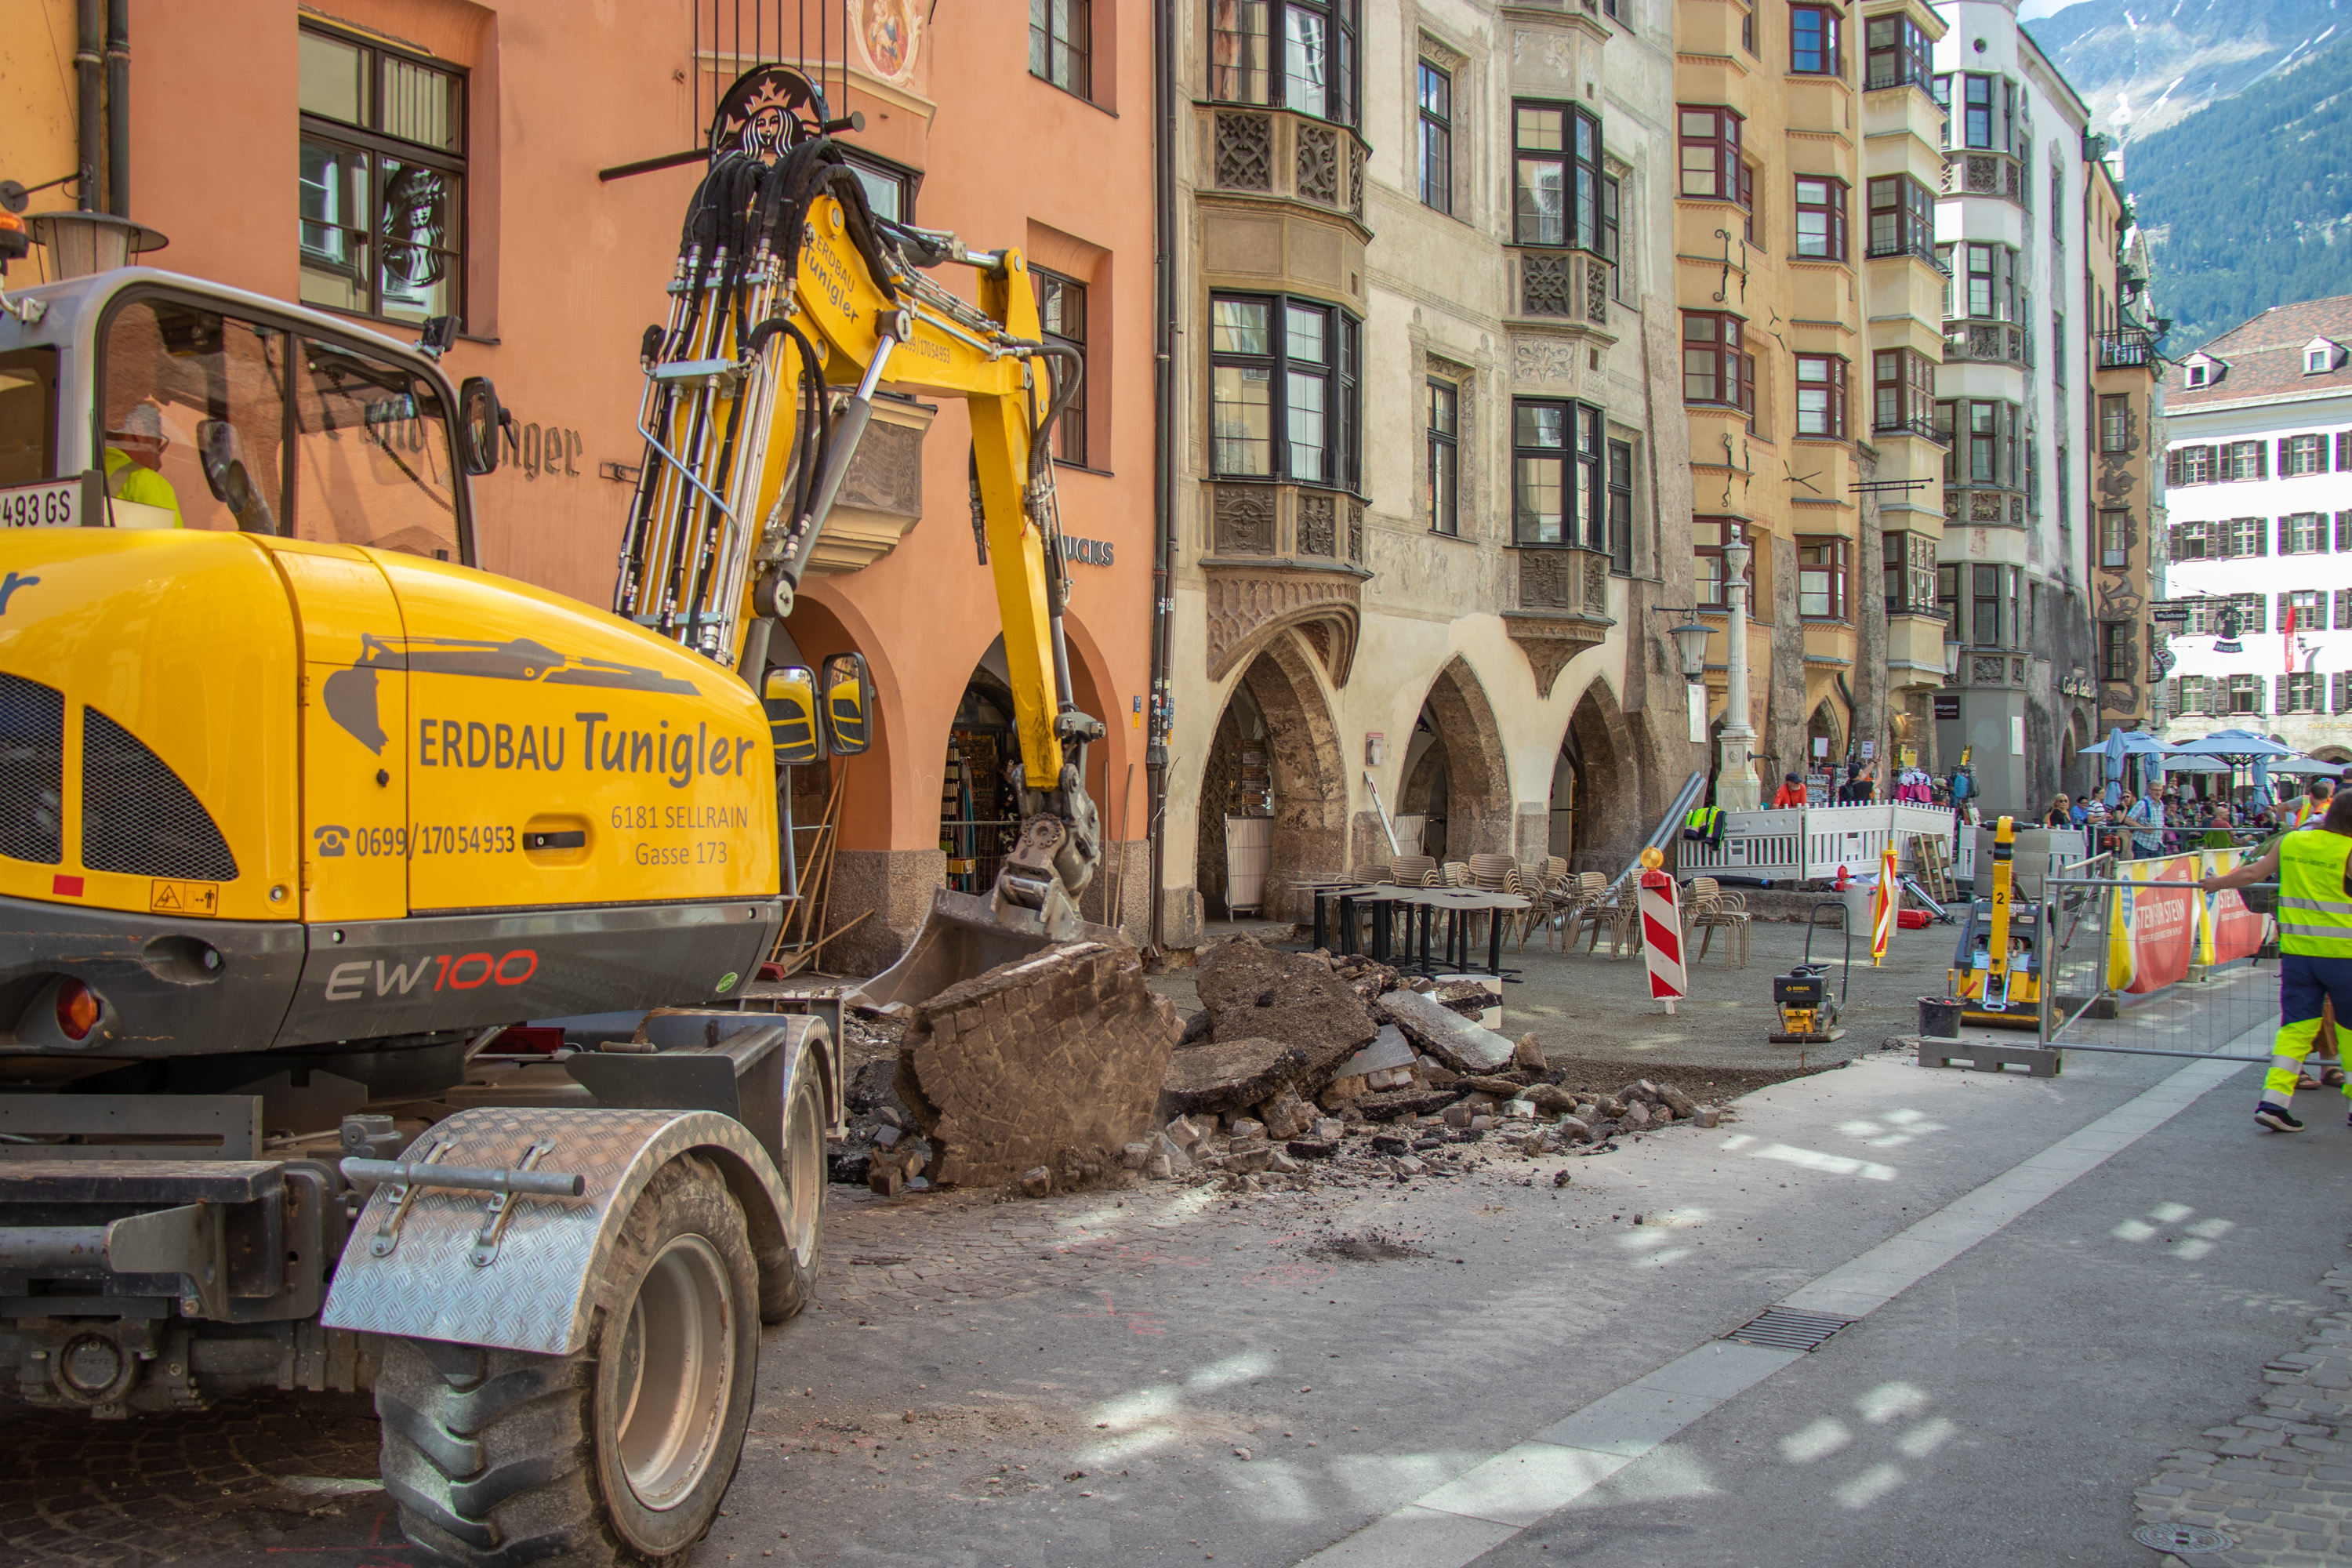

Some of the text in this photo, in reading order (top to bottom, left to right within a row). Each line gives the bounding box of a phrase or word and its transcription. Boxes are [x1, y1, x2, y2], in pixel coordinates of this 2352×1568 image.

[816, 234, 855, 293] ERDBAU
[804, 243, 859, 325] Tunigler
[45, 489, 71, 524] GS
[2216, 643, 2241, 652] Happ
[419, 712, 755, 789] ERDBAU Tunigler
[612, 806, 748, 829] 6181 SELLRAIN
[356, 822, 515, 861] 0699/17054953
[635, 841, 728, 866] Gasse 173
[1996, 891, 2005, 905] 2
[2164, 898, 2185, 924] STEIN
[325, 949, 539, 1001] EW100
